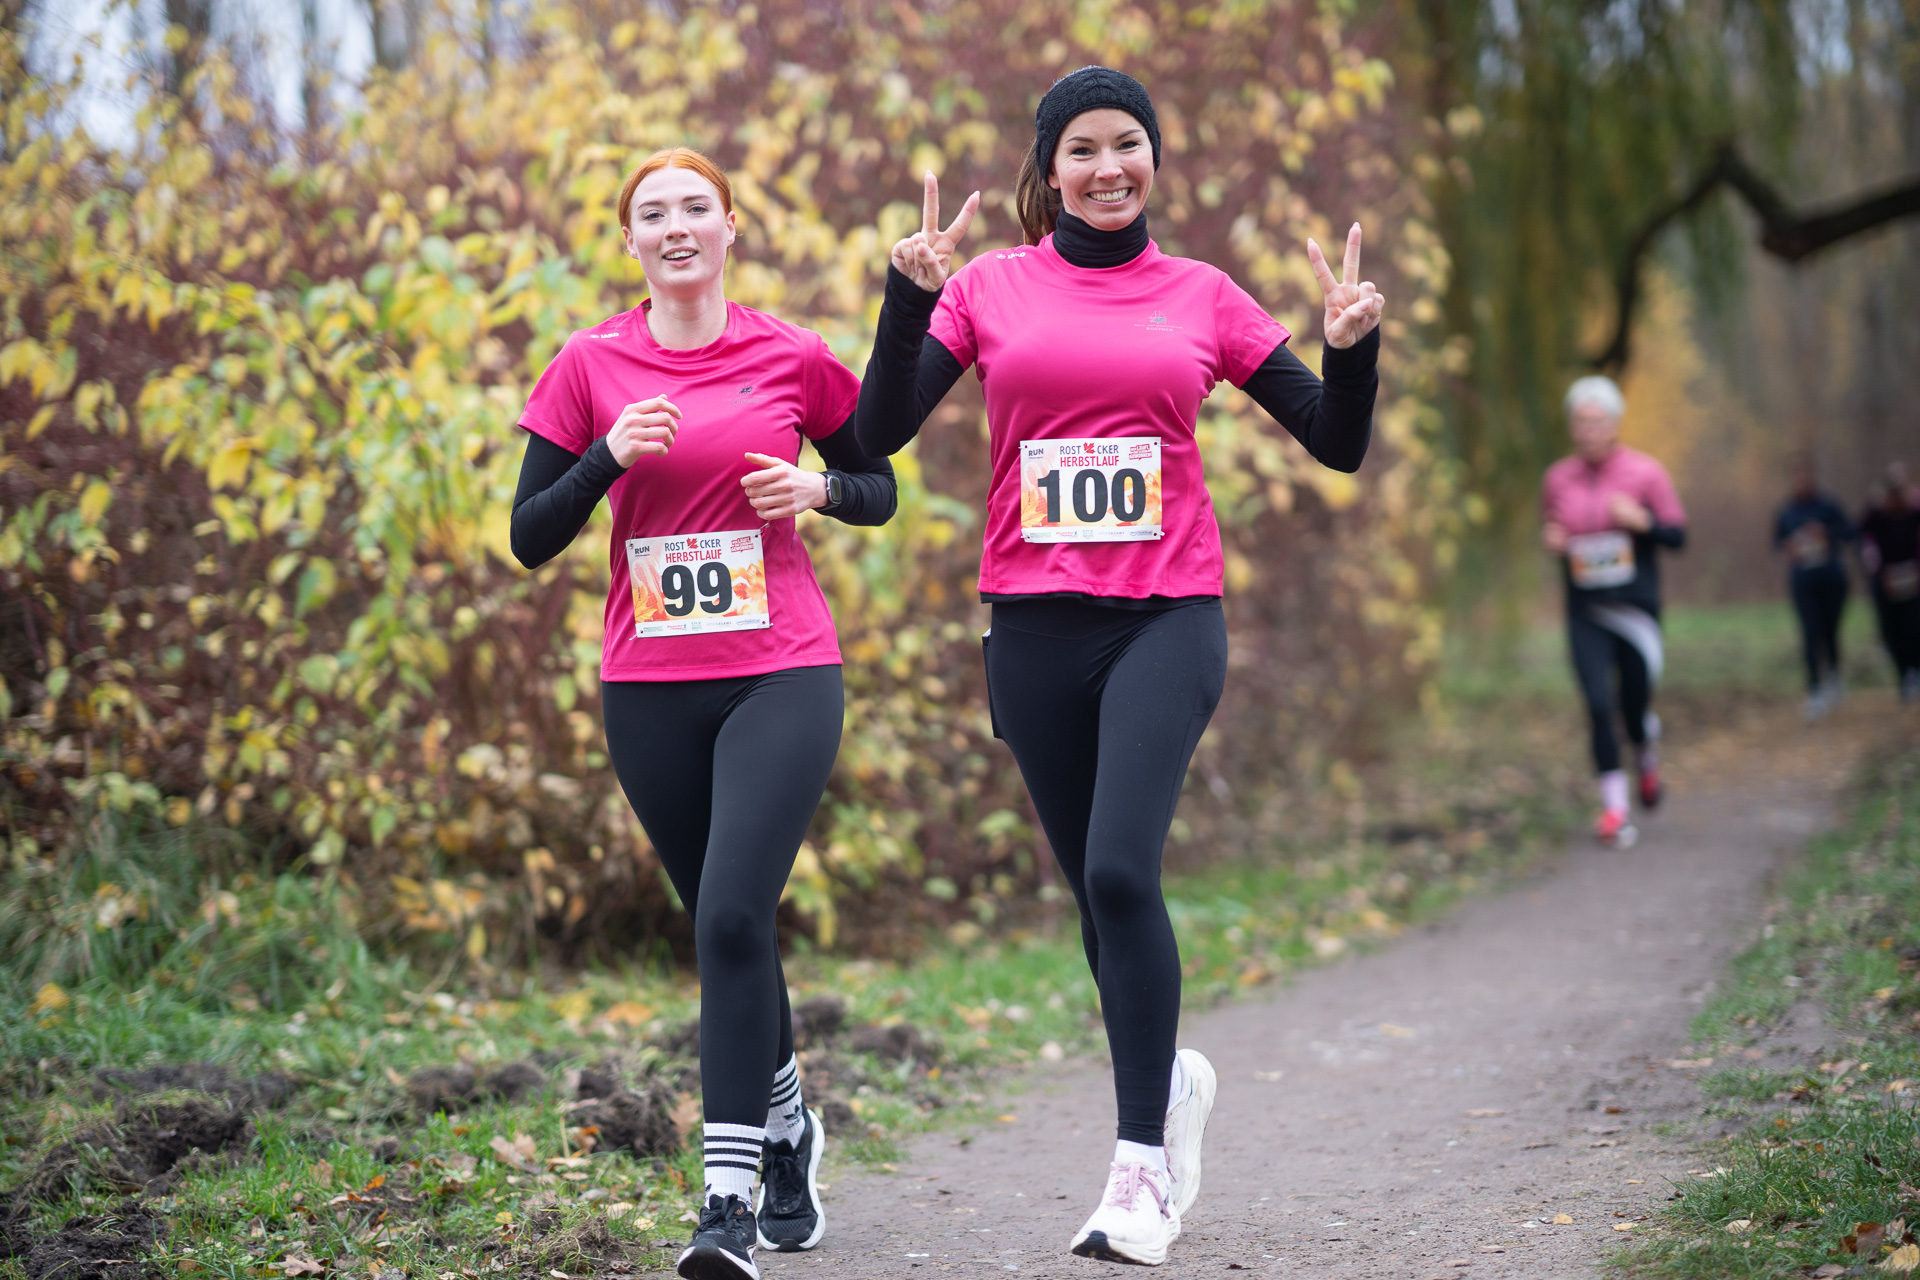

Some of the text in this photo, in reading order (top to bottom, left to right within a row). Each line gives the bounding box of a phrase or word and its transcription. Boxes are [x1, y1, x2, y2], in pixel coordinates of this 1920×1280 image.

[1028, 448, 1044, 457] RUN
[1059, 455, 1120, 467] HERBSTLAUF
[1037, 468, 1146, 523] 100
[634, 545, 650, 555] RUN
[665, 549, 723, 563] HERBSTLAUF
[661, 561, 733, 617] 99
